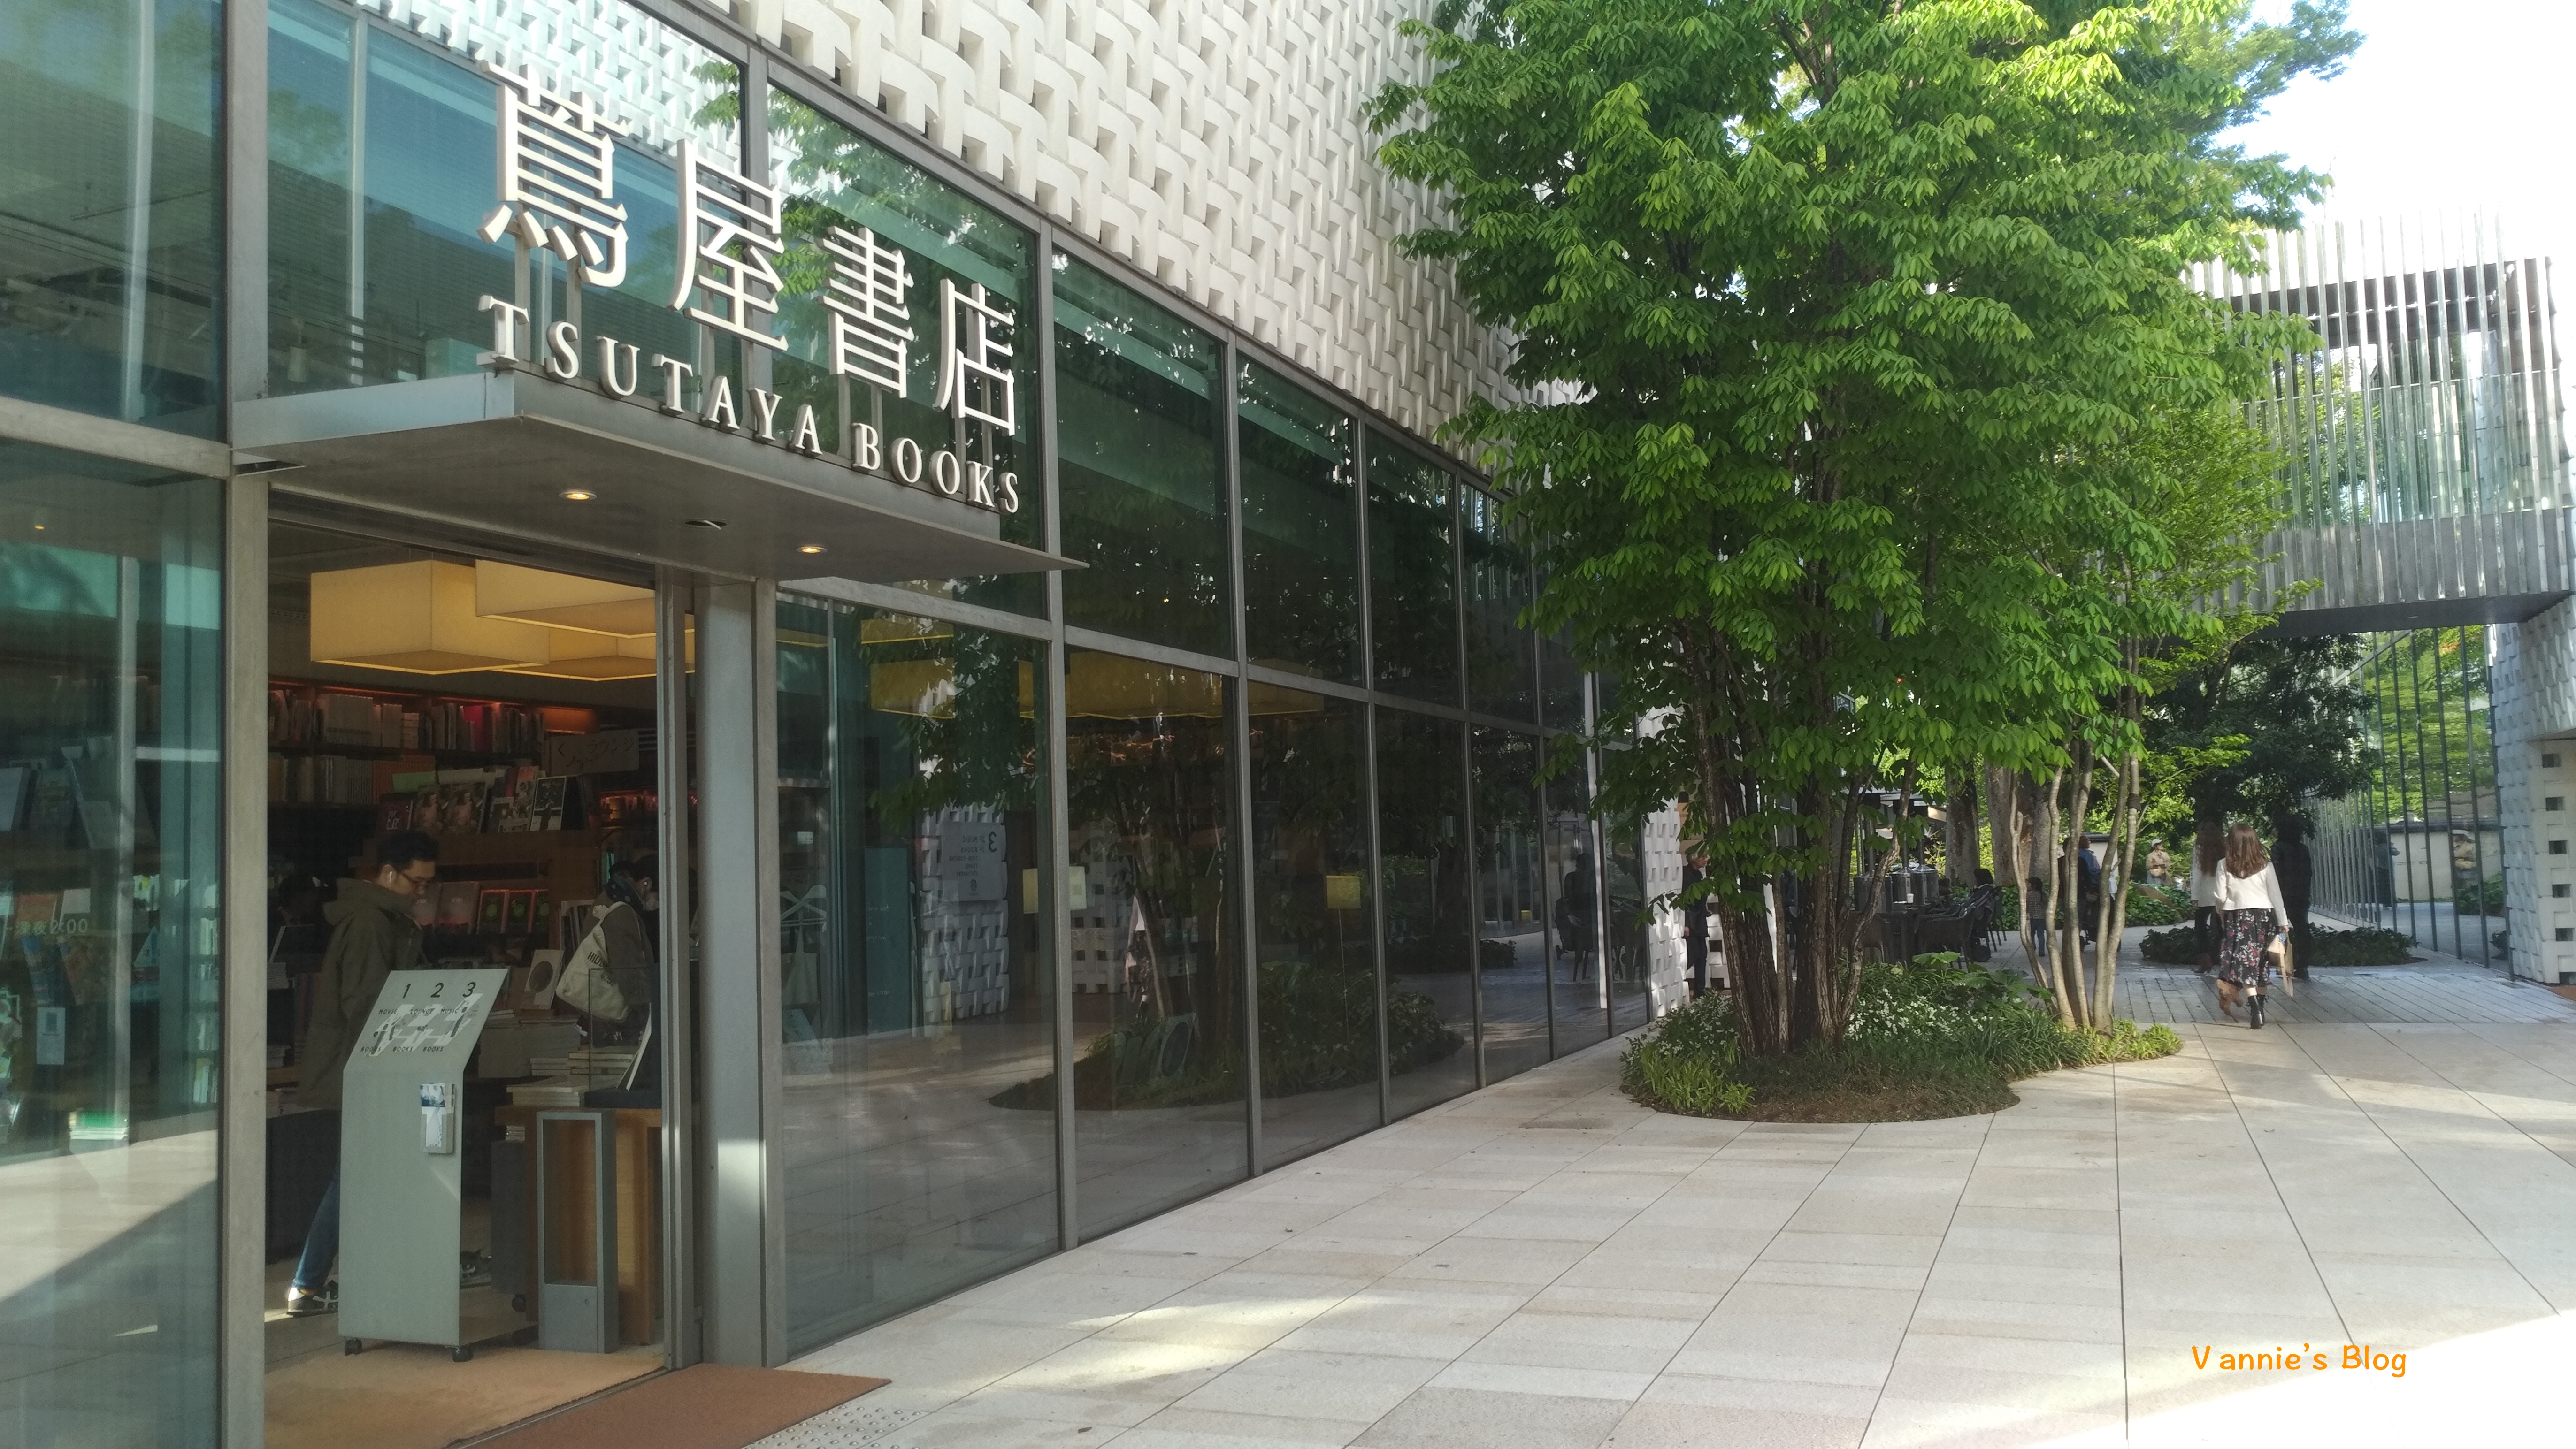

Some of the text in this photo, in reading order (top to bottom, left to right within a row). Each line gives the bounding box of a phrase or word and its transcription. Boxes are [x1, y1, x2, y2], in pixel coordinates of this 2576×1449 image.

[478, 61, 1016, 436] 蔦屋書店
[477, 295, 1019, 514] TSUTAYA BOOKS
[402, 982, 476, 999] 1 2 3
